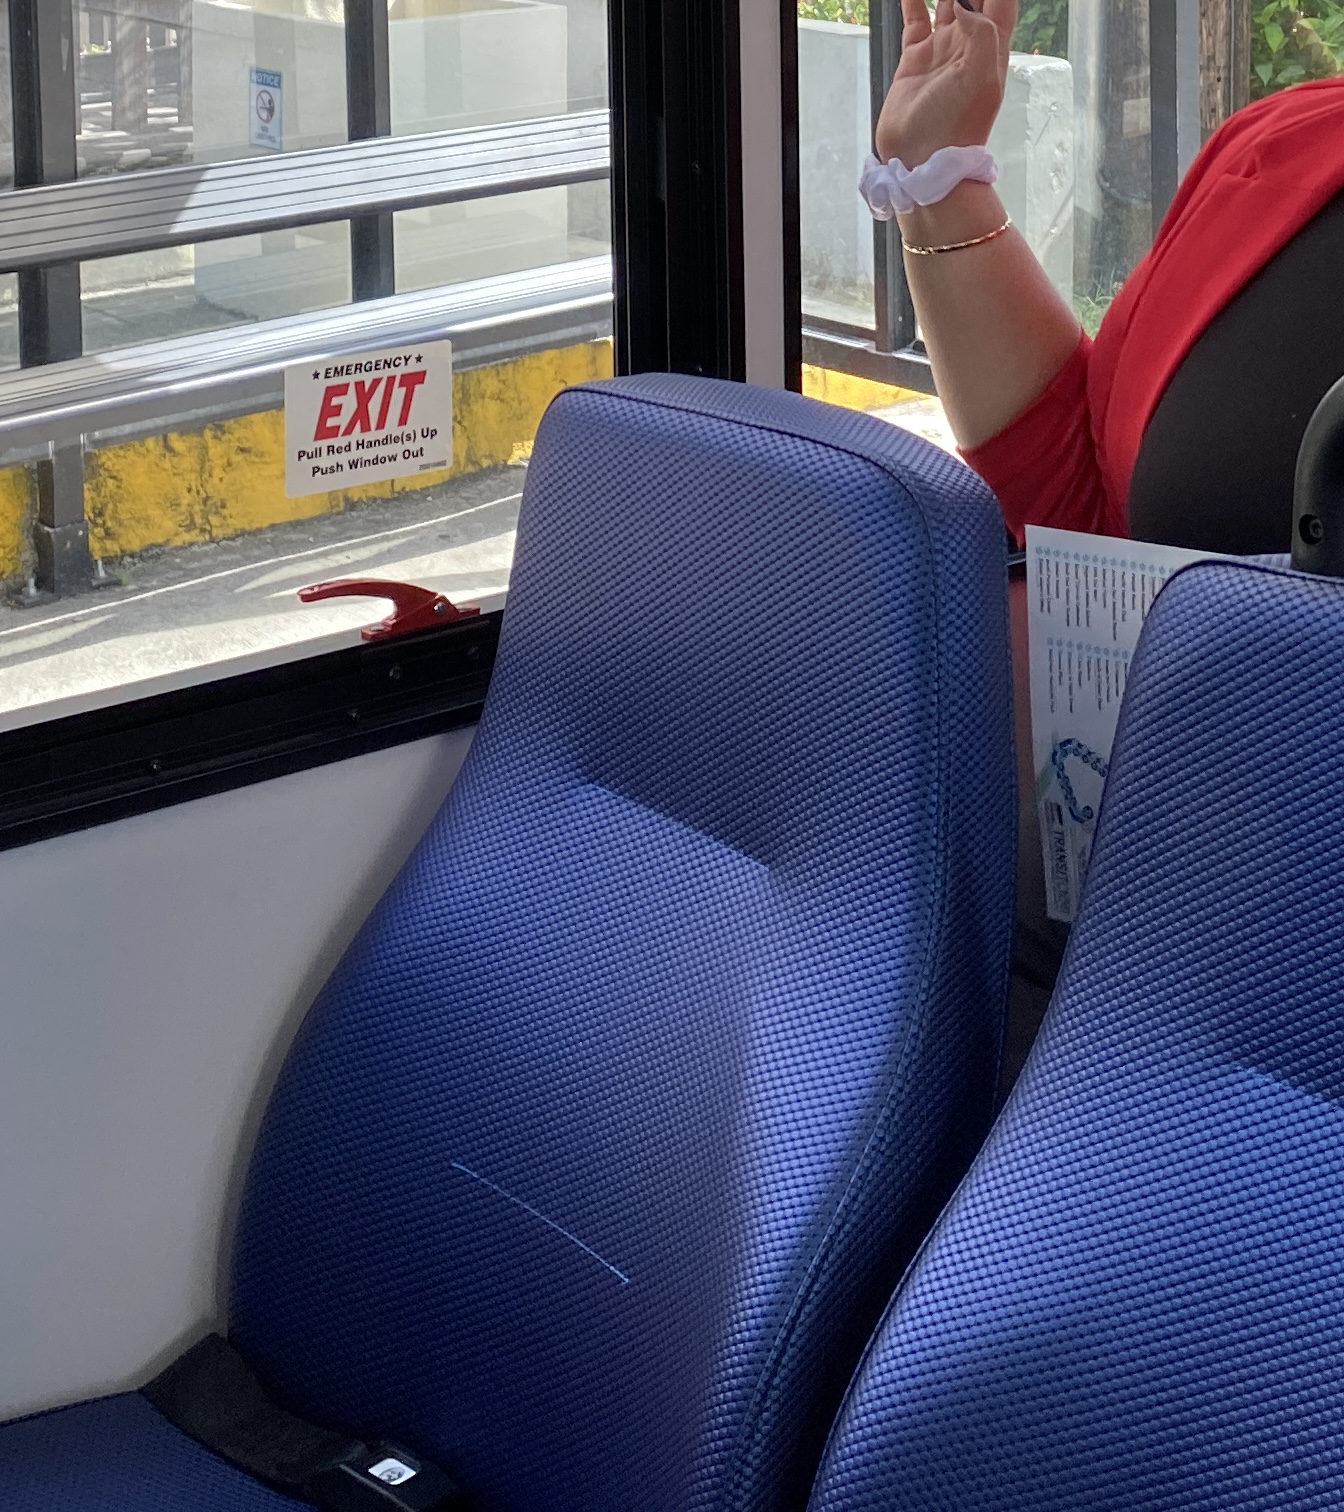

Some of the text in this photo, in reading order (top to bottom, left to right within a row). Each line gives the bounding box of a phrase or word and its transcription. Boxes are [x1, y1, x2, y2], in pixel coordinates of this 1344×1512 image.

[323, 354, 413, 380] EMERGENCY
[312, 369, 428, 442] EXIT
[297, 426, 438, 462] Pull Red Handle(s) Up
[311, 446, 425, 478] Push Window Out
